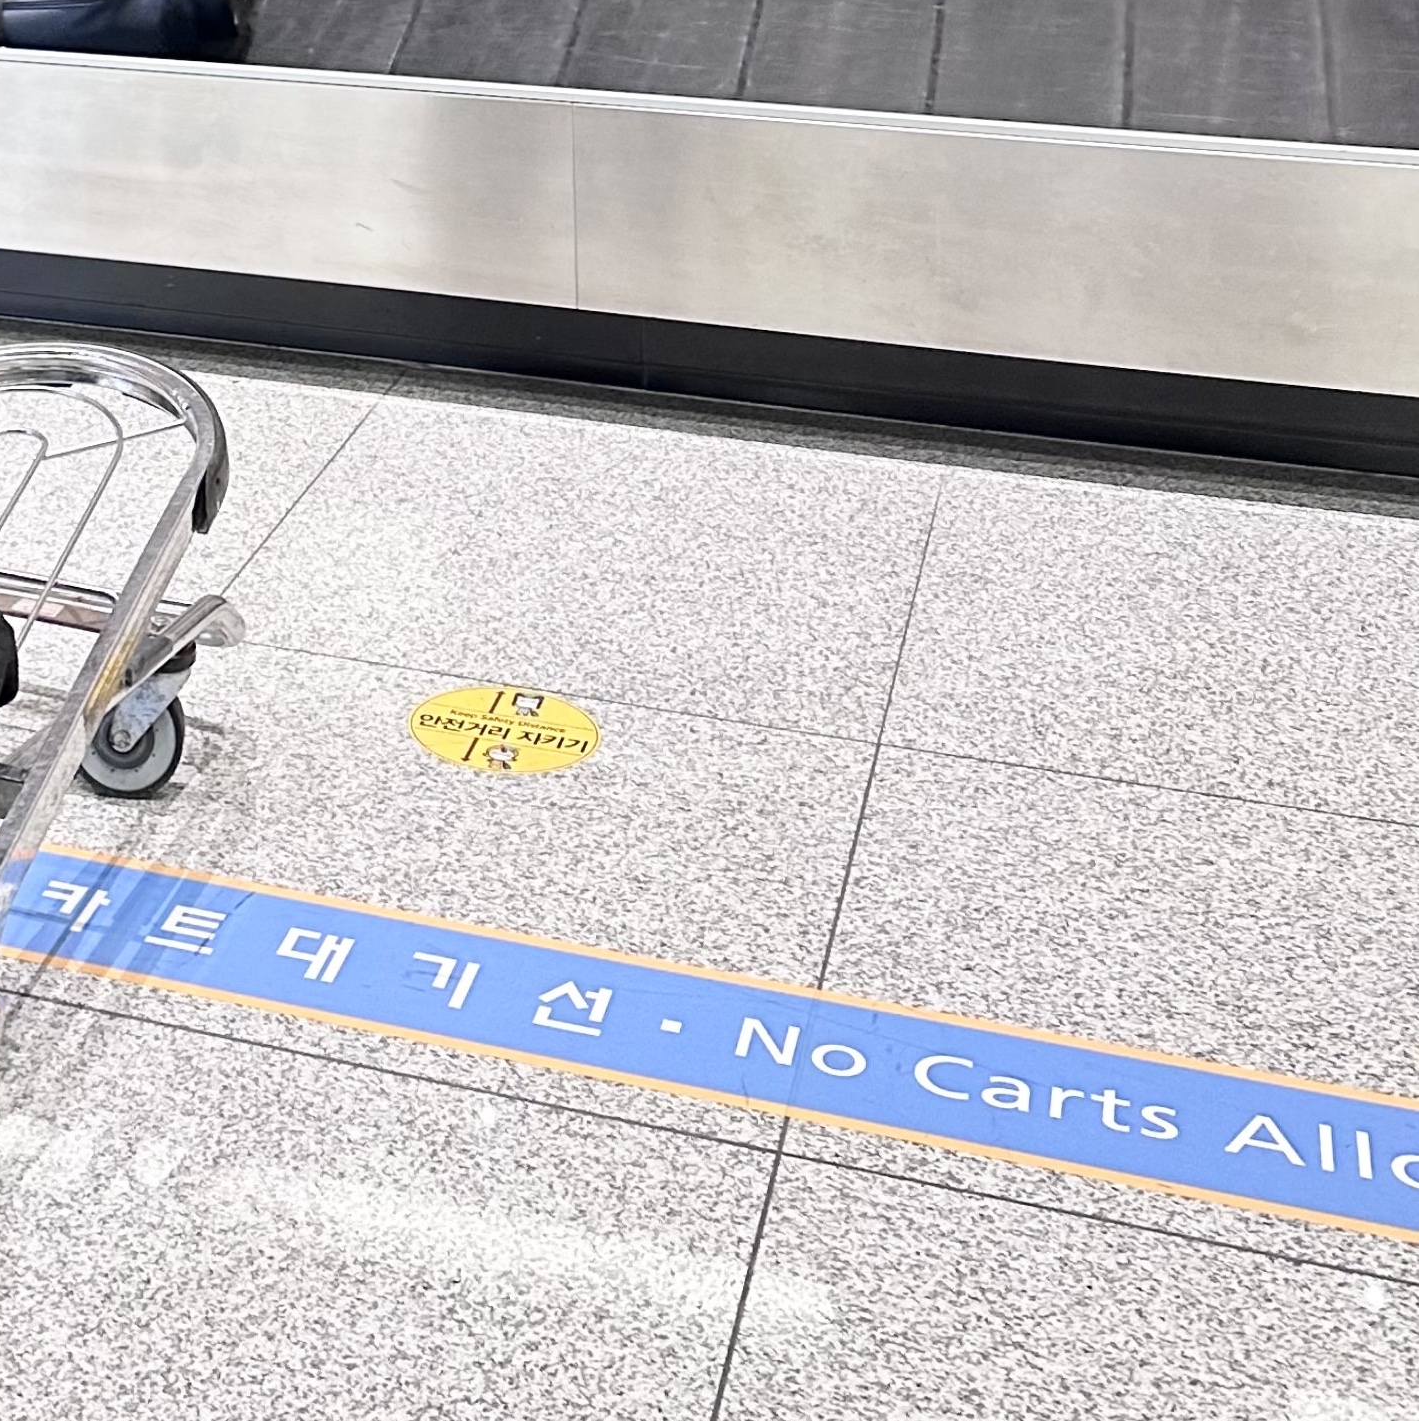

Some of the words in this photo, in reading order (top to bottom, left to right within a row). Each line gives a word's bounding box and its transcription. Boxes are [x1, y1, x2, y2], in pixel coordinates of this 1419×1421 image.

[419, 713, 511, 740] 안전거리
[734, 1016, 868, 1078] No
[913, 1054, 1179, 1141] Carts
